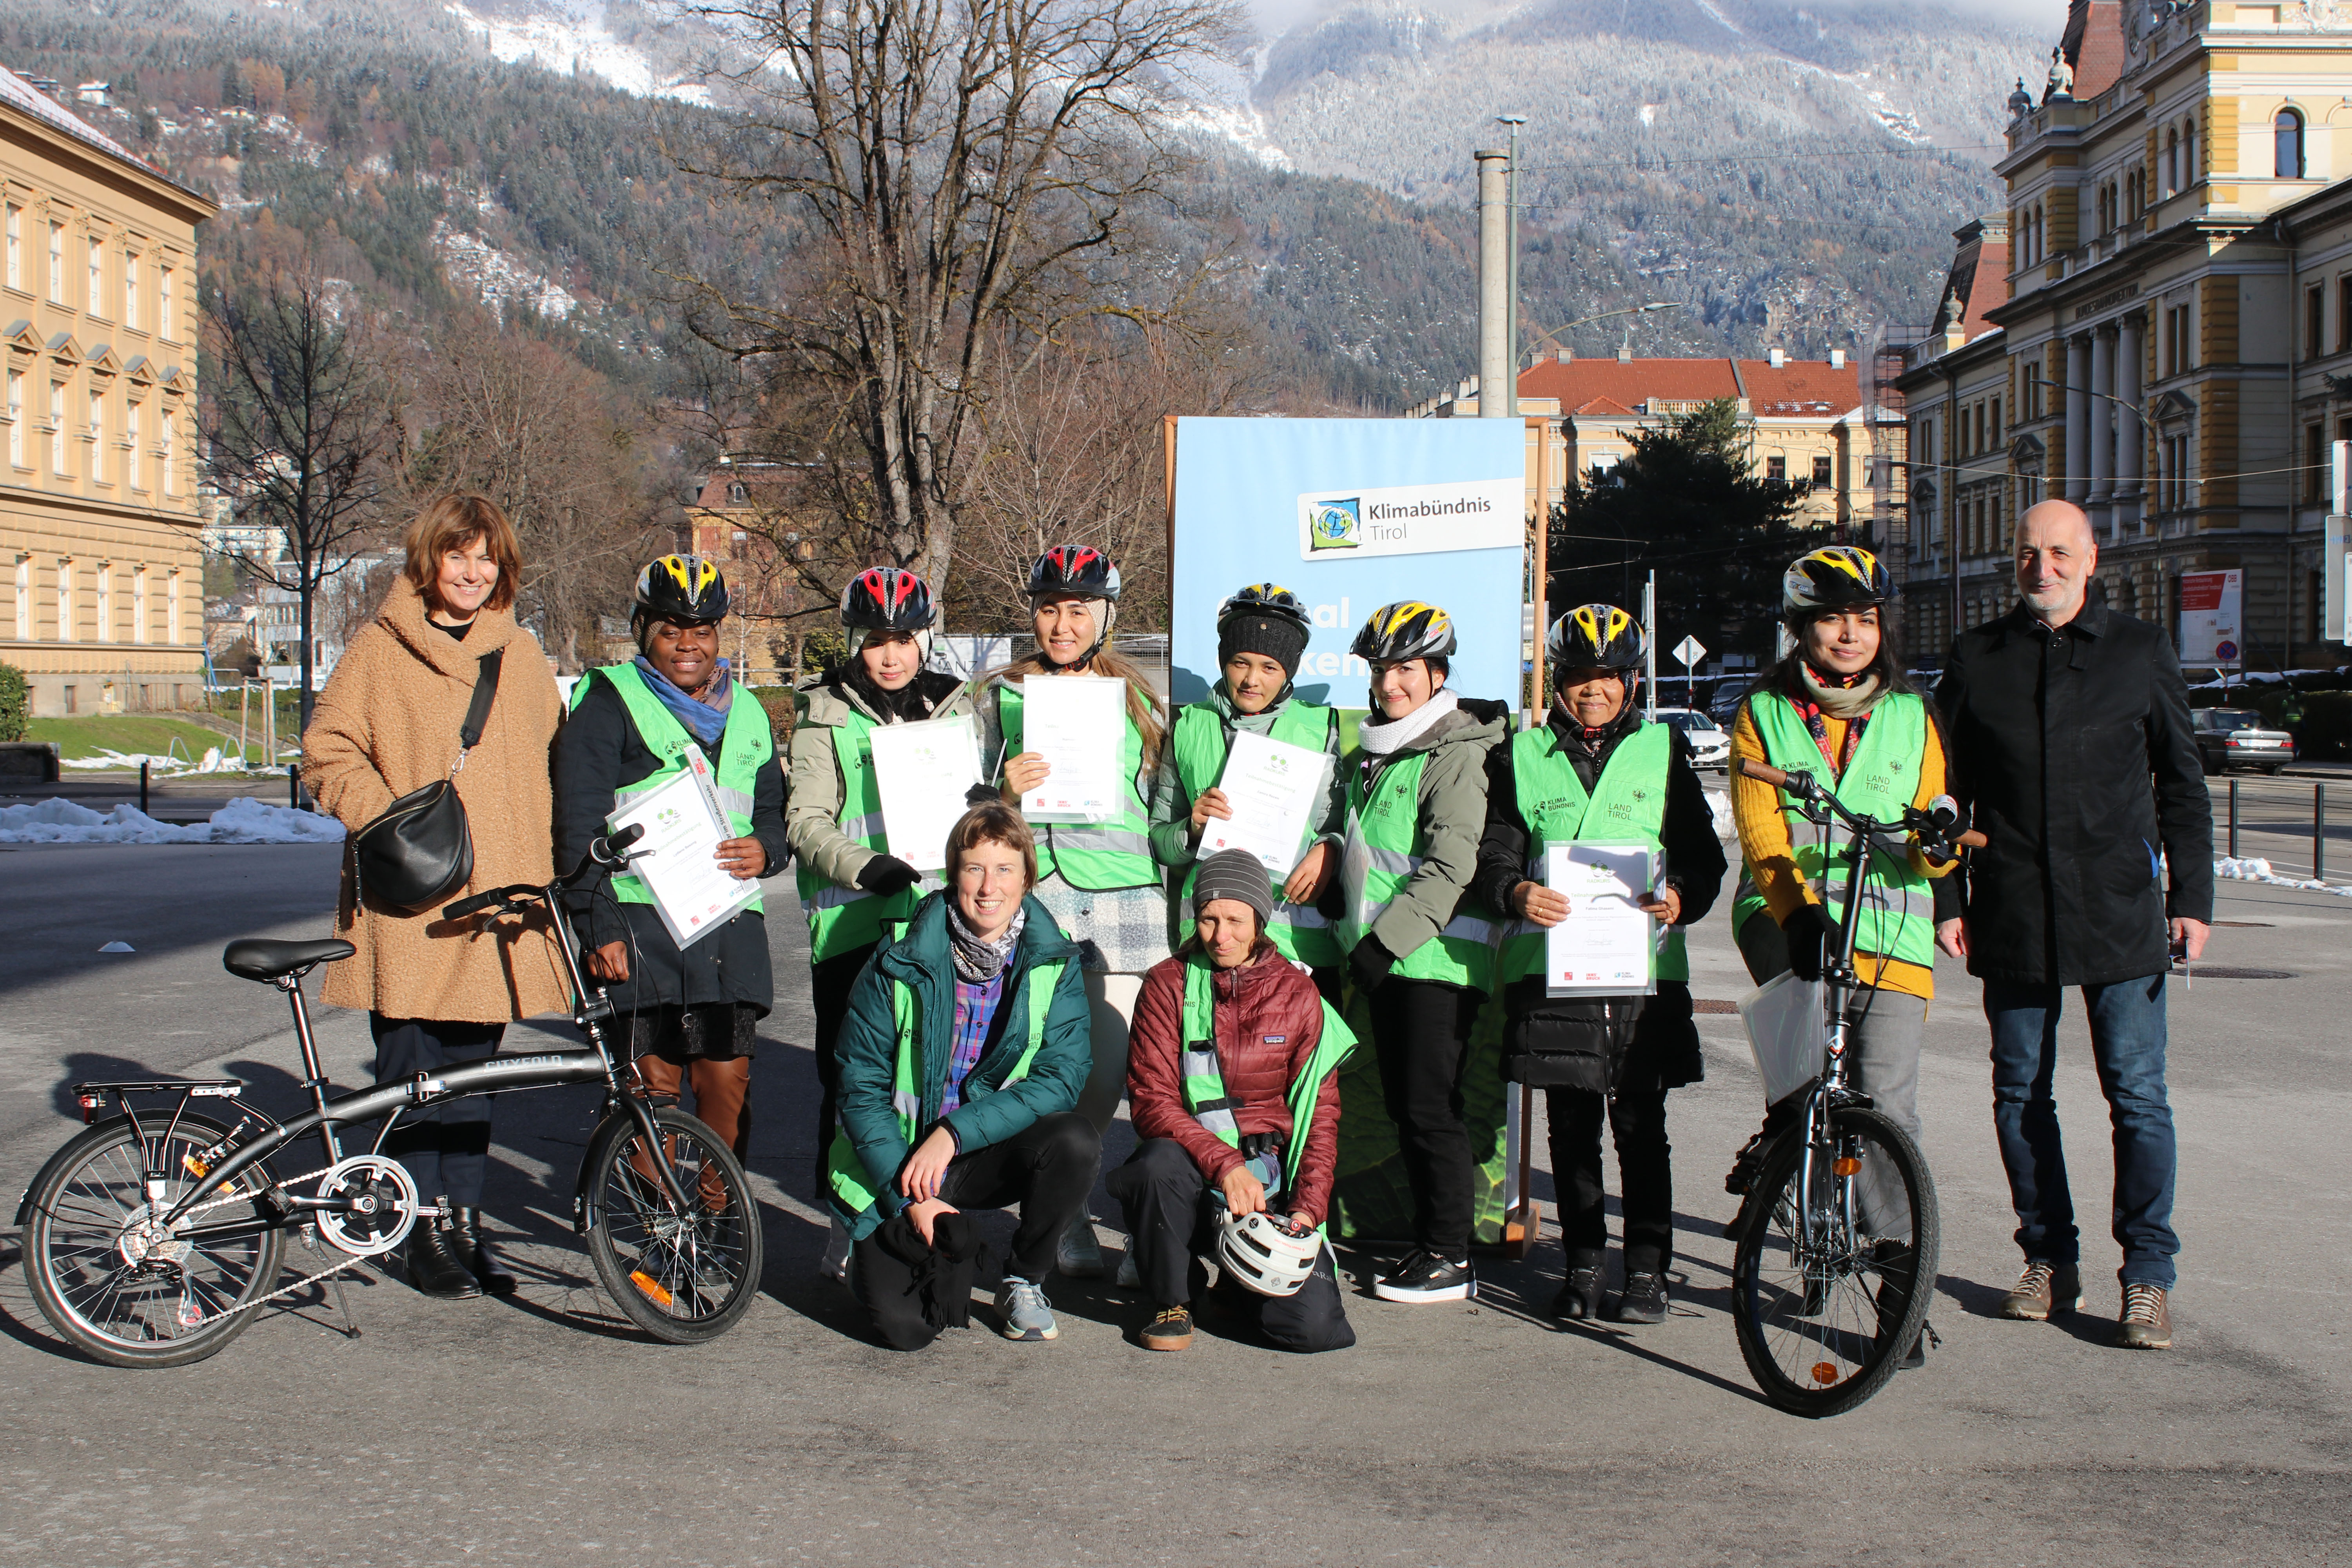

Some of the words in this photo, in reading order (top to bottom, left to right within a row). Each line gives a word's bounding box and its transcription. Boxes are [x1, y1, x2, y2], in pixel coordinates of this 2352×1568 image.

[1369, 497, 1491, 520] Klimabündnis
[1370, 524, 1407, 541] Tirol
[676, 738, 693, 746] KLIMA
[736, 751, 756, 760] LAND
[736, 759, 756, 769] TIROL
[1263, 766, 1285, 777] RADKURS
[1245, 773, 1296, 793] Teilnahmebestätigung
[1867, 774, 1890, 785] LAND
[1866, 783, 1889, 794] TIROL
[705, 784, 726, 826] Straßenverkehr
[1375, 800, 1392, 809] LAND
[1547, 797, 1567, 806] KLIMA
[1548, 801, 1576, 811] BÜNDNIS
[1608, 802, 1632, 812] LAND
[1374, 807, 1391, 817] TIROL
[1608, 810, 1632, 821] TIROL
[483, 1055, 563, 1072] CITYFOLD
[214, 1158, 239, 1180] CYCLING
